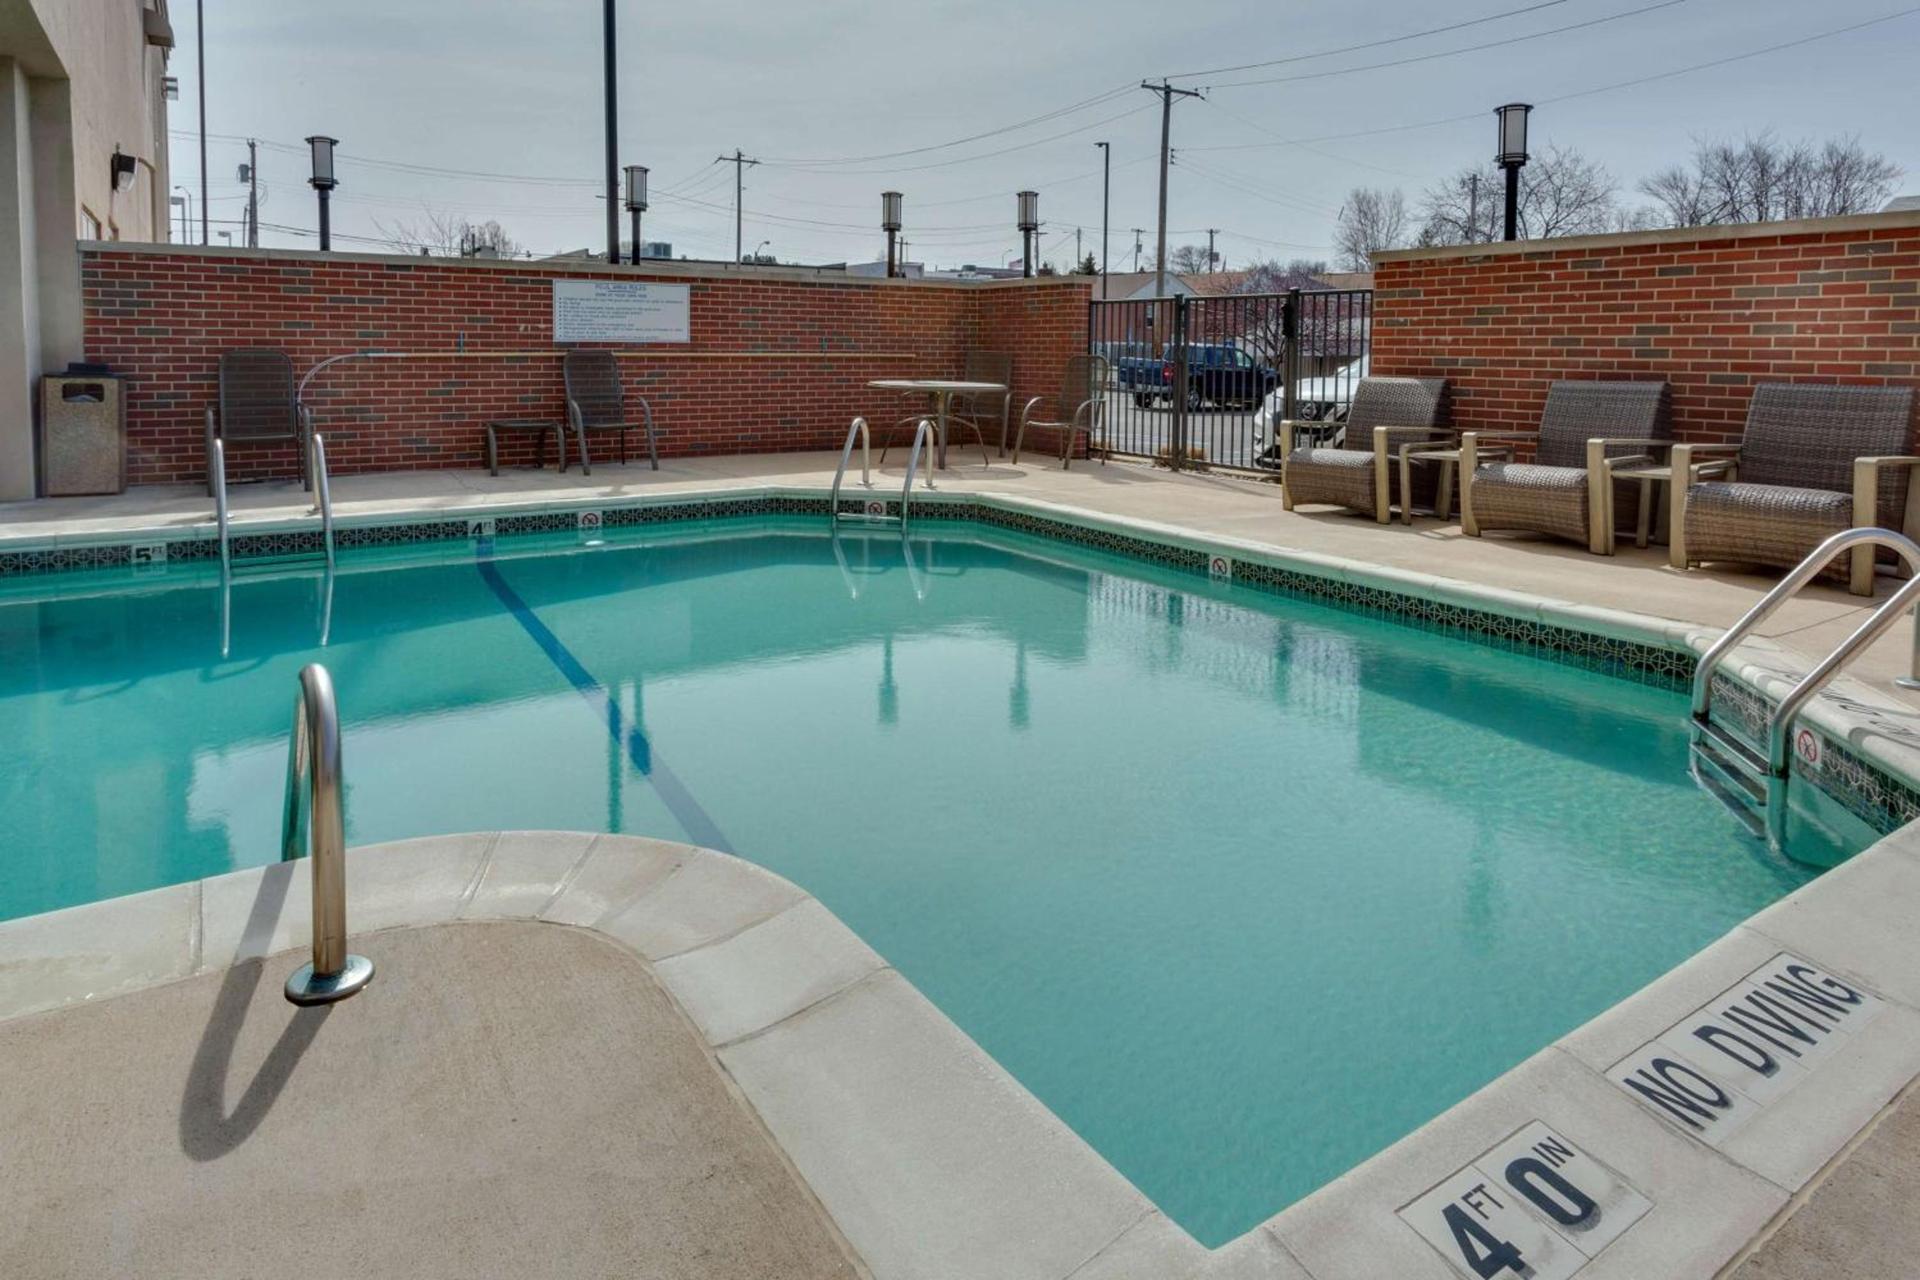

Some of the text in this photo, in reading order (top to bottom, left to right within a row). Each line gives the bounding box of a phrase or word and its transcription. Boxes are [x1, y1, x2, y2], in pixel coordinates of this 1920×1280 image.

[136, 547, 151, 561] 5
[472, 522, 483, 534] 4
[1622, 964, 1865, 1131] NO DIVING
[1442, 1136, 1602, 1280] 4 FT 0 IN
